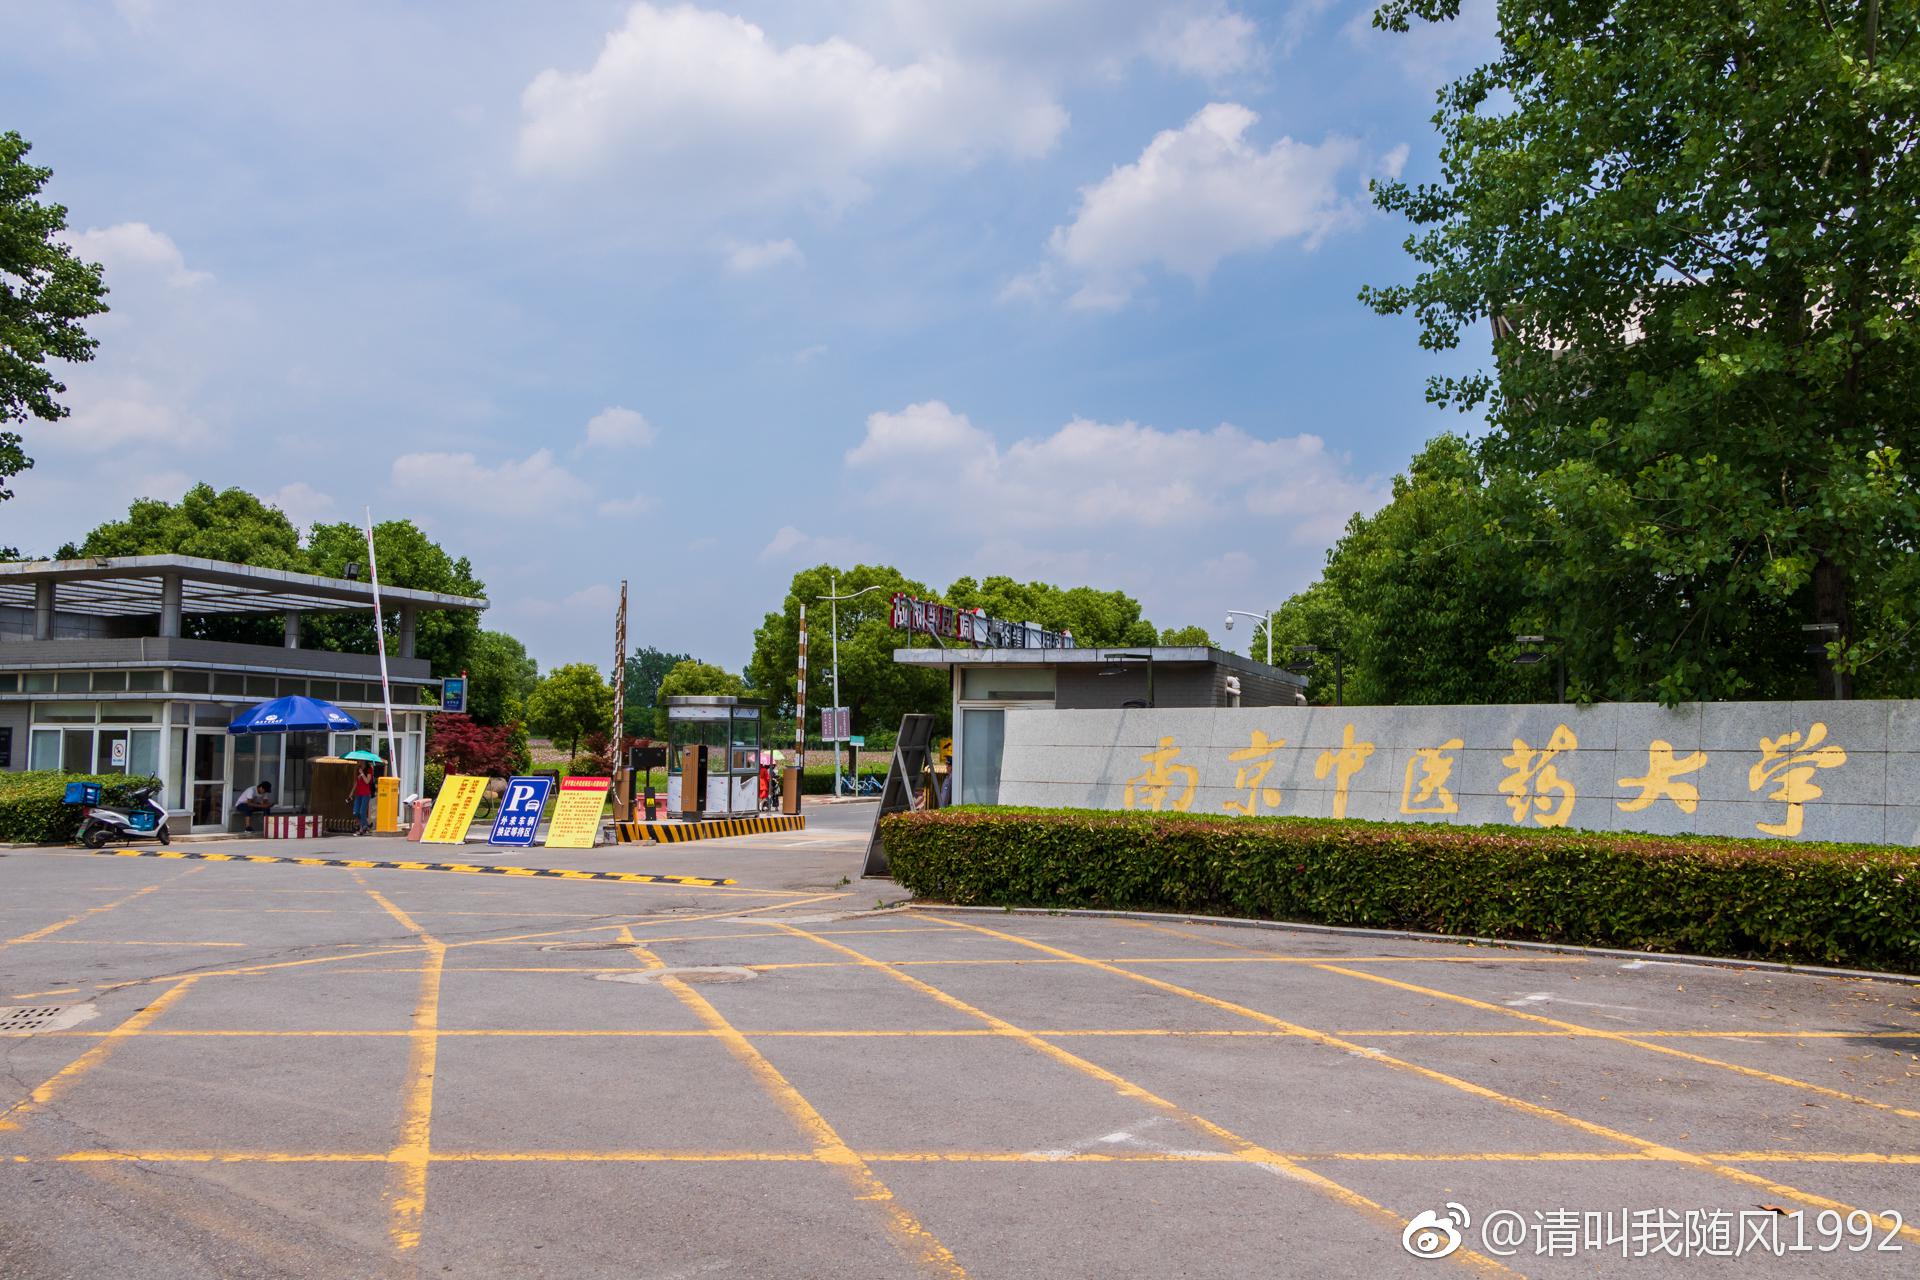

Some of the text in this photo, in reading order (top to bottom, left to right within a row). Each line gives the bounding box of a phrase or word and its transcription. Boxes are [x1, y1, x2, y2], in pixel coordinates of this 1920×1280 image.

[505, 785, 535, 811] P
[1123, 722, 1848, 837] 南京中医药大学
